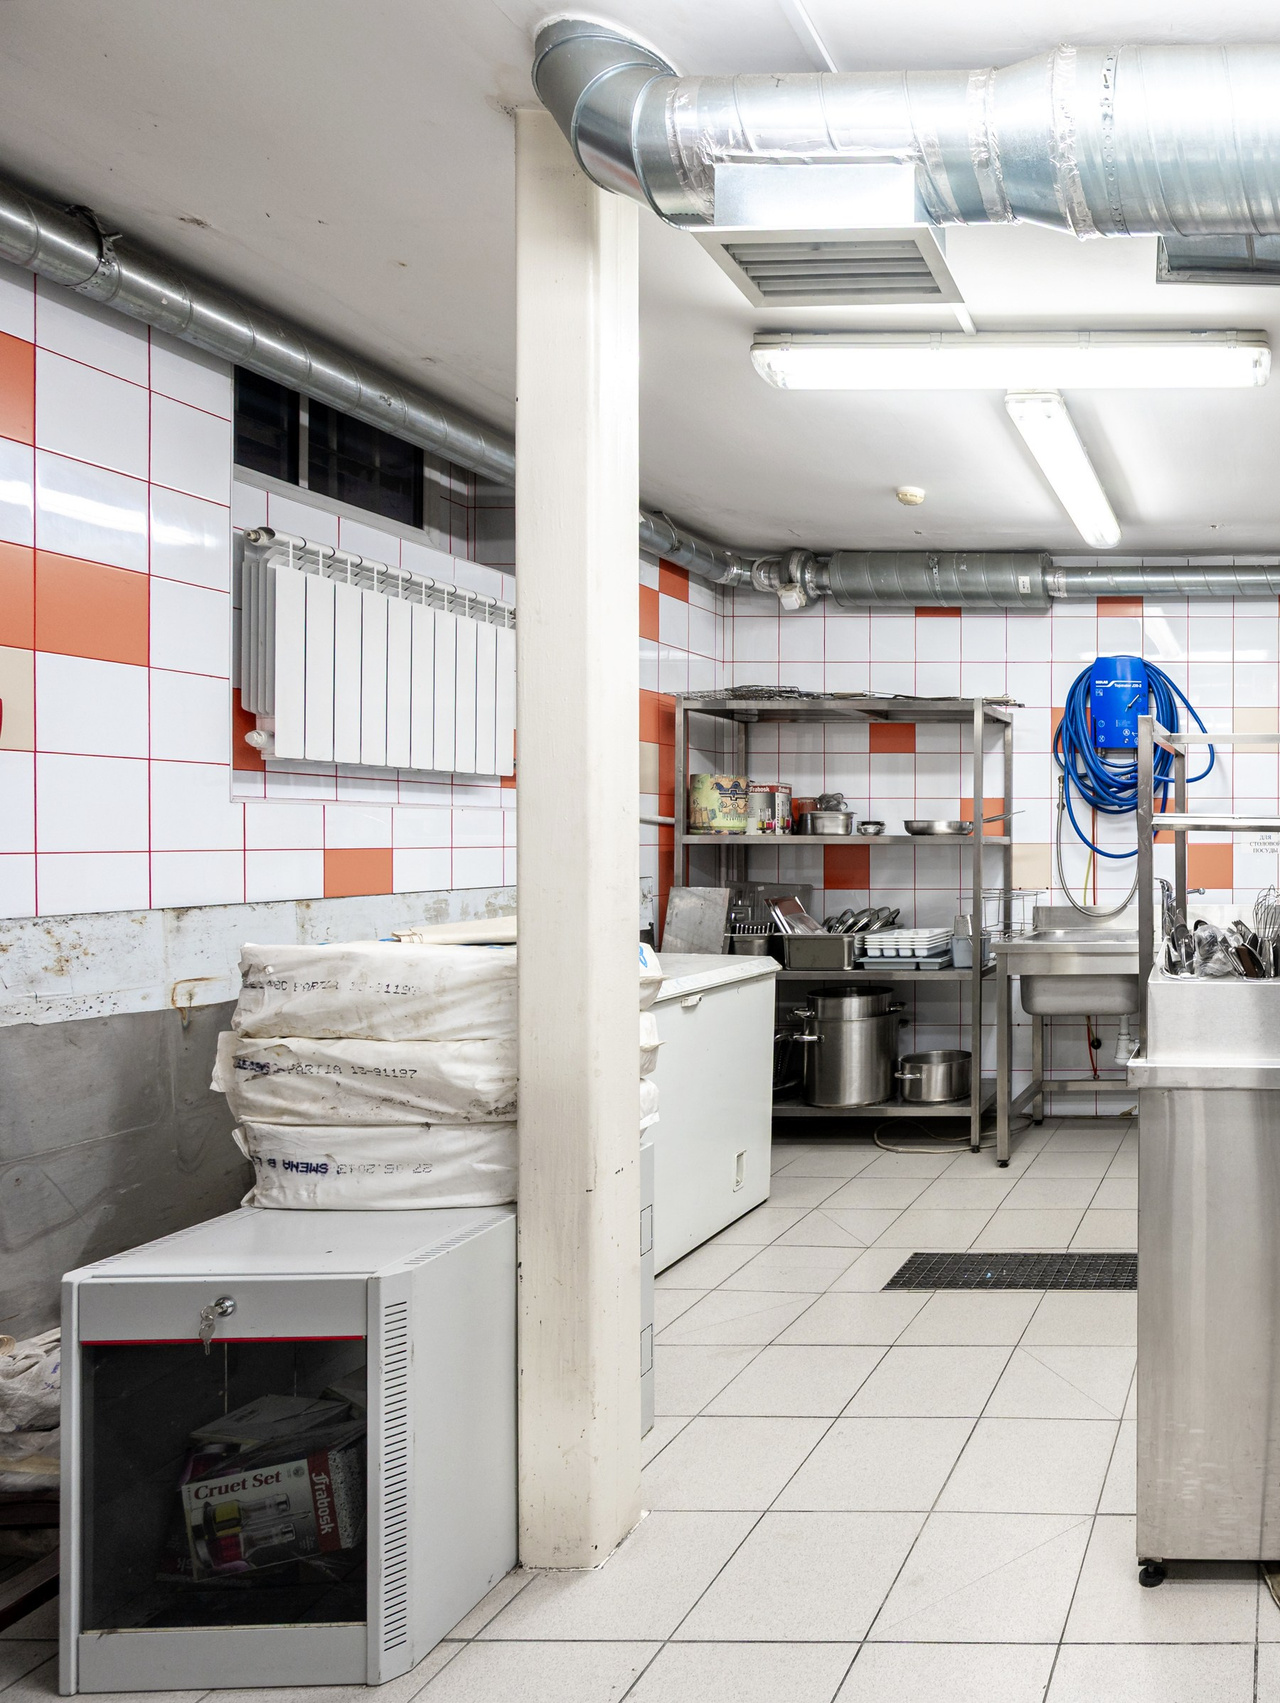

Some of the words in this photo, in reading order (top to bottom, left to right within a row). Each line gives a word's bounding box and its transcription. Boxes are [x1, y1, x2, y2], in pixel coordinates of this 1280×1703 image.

[282, 1158, 329, 1175] SMENA
[193, 1477, 249, 1501] Cruet
[251, 1470, 283, 1489] Set
